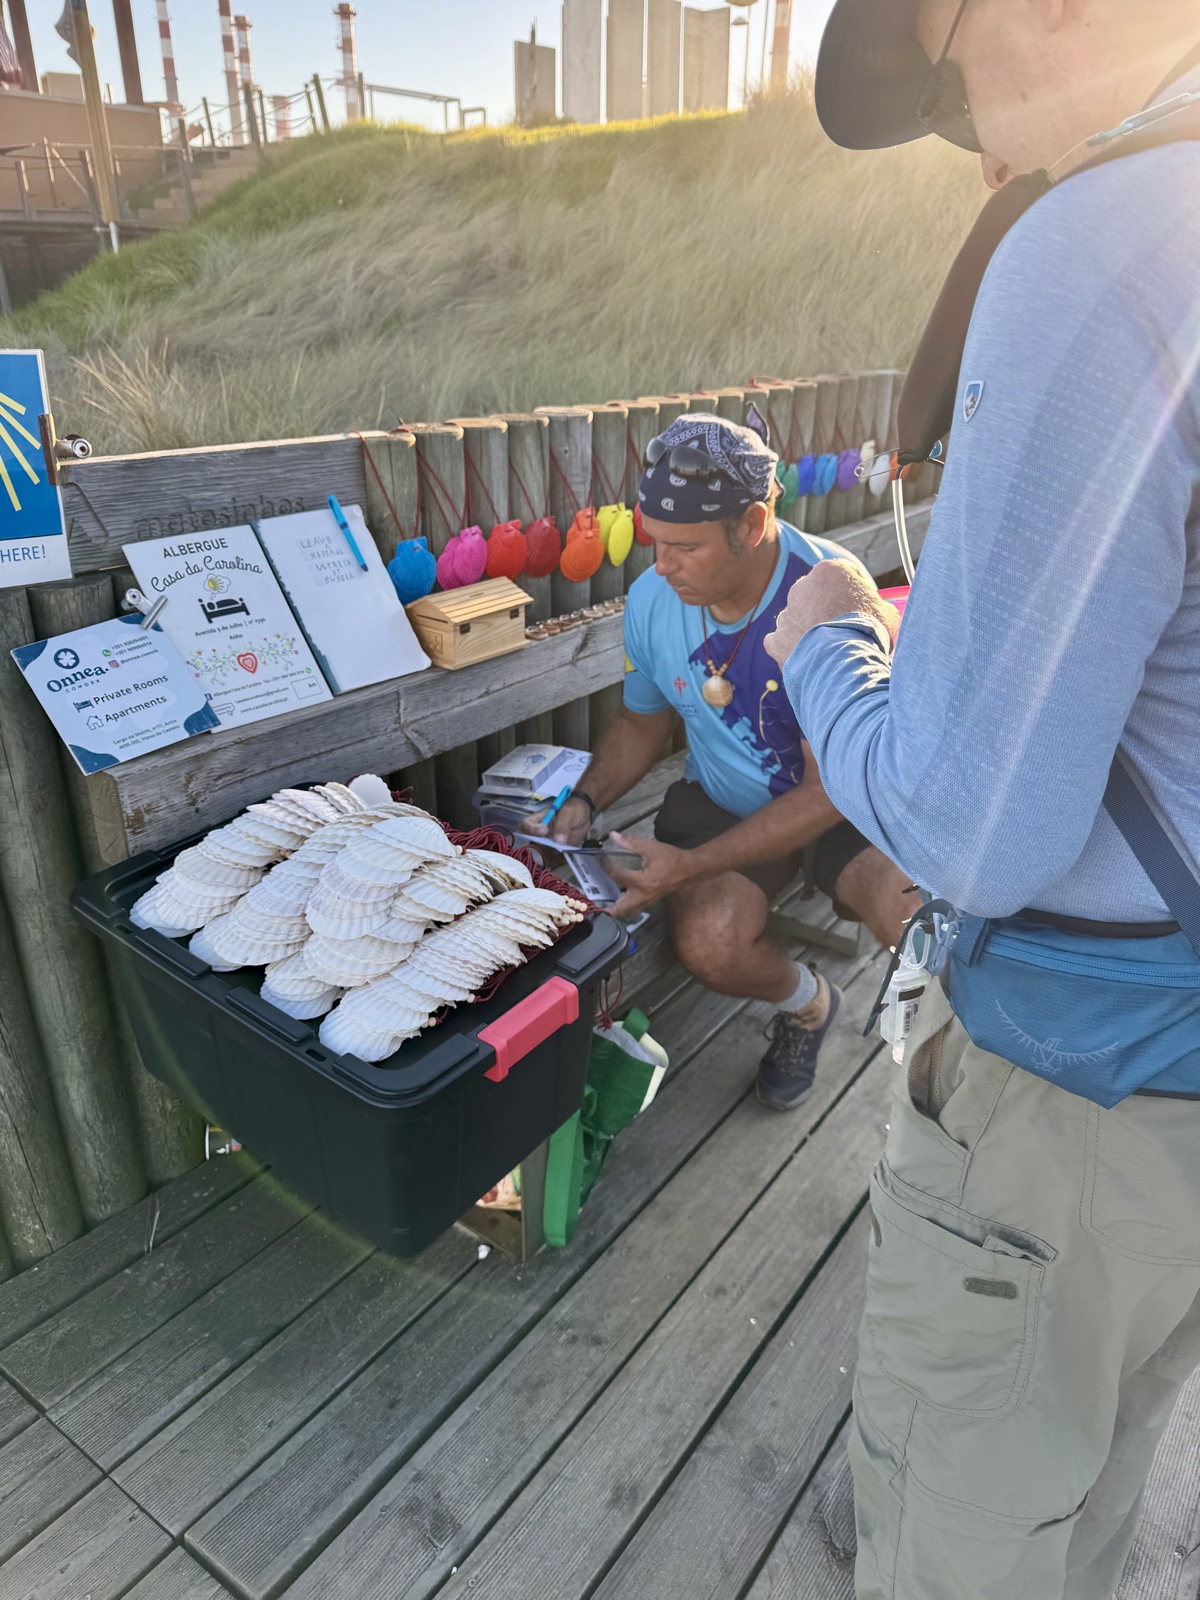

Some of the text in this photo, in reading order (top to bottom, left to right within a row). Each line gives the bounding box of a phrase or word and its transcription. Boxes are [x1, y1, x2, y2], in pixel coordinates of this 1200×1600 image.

[0, 544, 46, 563] HERE!
[163, 538, 228, 558] ALBERGUE
[300, 536, 332, 549] LEAVE
[151, 555, 262, 592] Casa da Carolina
[46, 665, 109, 692] Onnea.
[65, 679, 101, 693] COWORK
[93, 675, 169, 705] Private Rooms
[104, 695, 167, 722] Apartments
